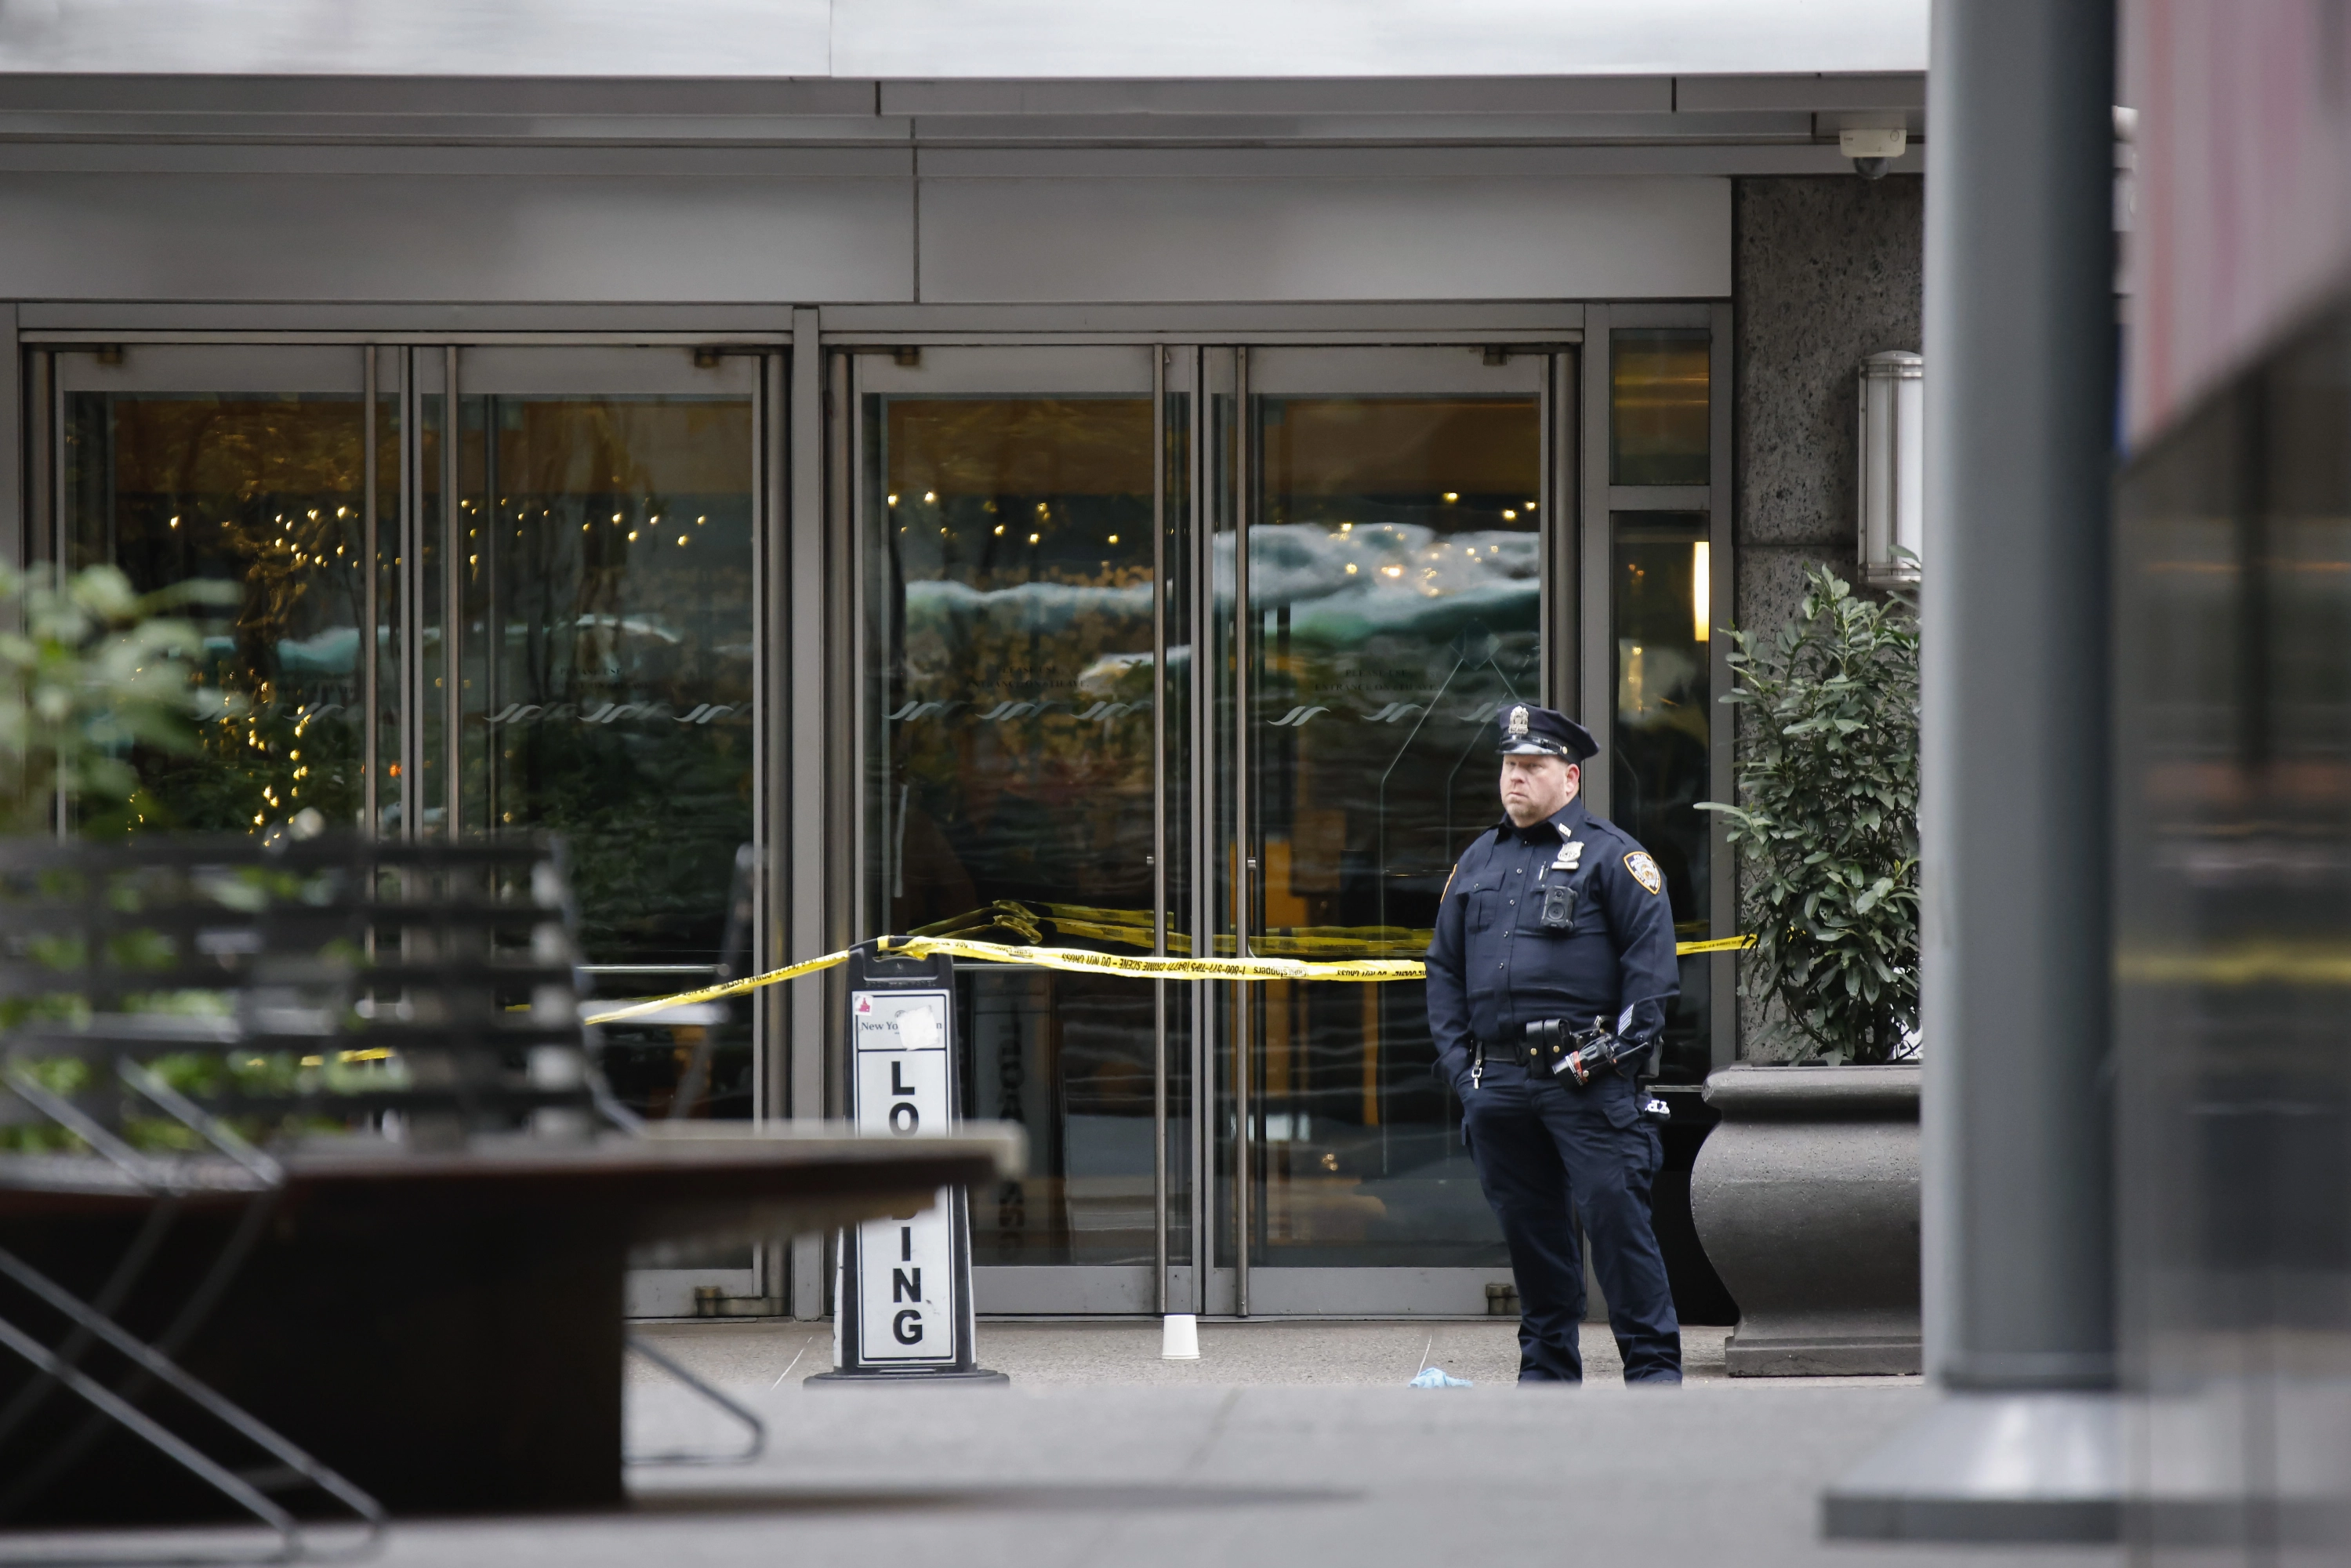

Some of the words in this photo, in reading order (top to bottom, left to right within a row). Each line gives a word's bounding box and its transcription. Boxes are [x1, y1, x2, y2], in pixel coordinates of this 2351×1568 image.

[1118, 958, 1143, 971] SCENE
[1142, 961, 1166, 972] CRIME
[862, 1022, 883, 1030] New
[886, 1022, 898, 1030] Yo
[889, 1061, 923, 1345] LOING
